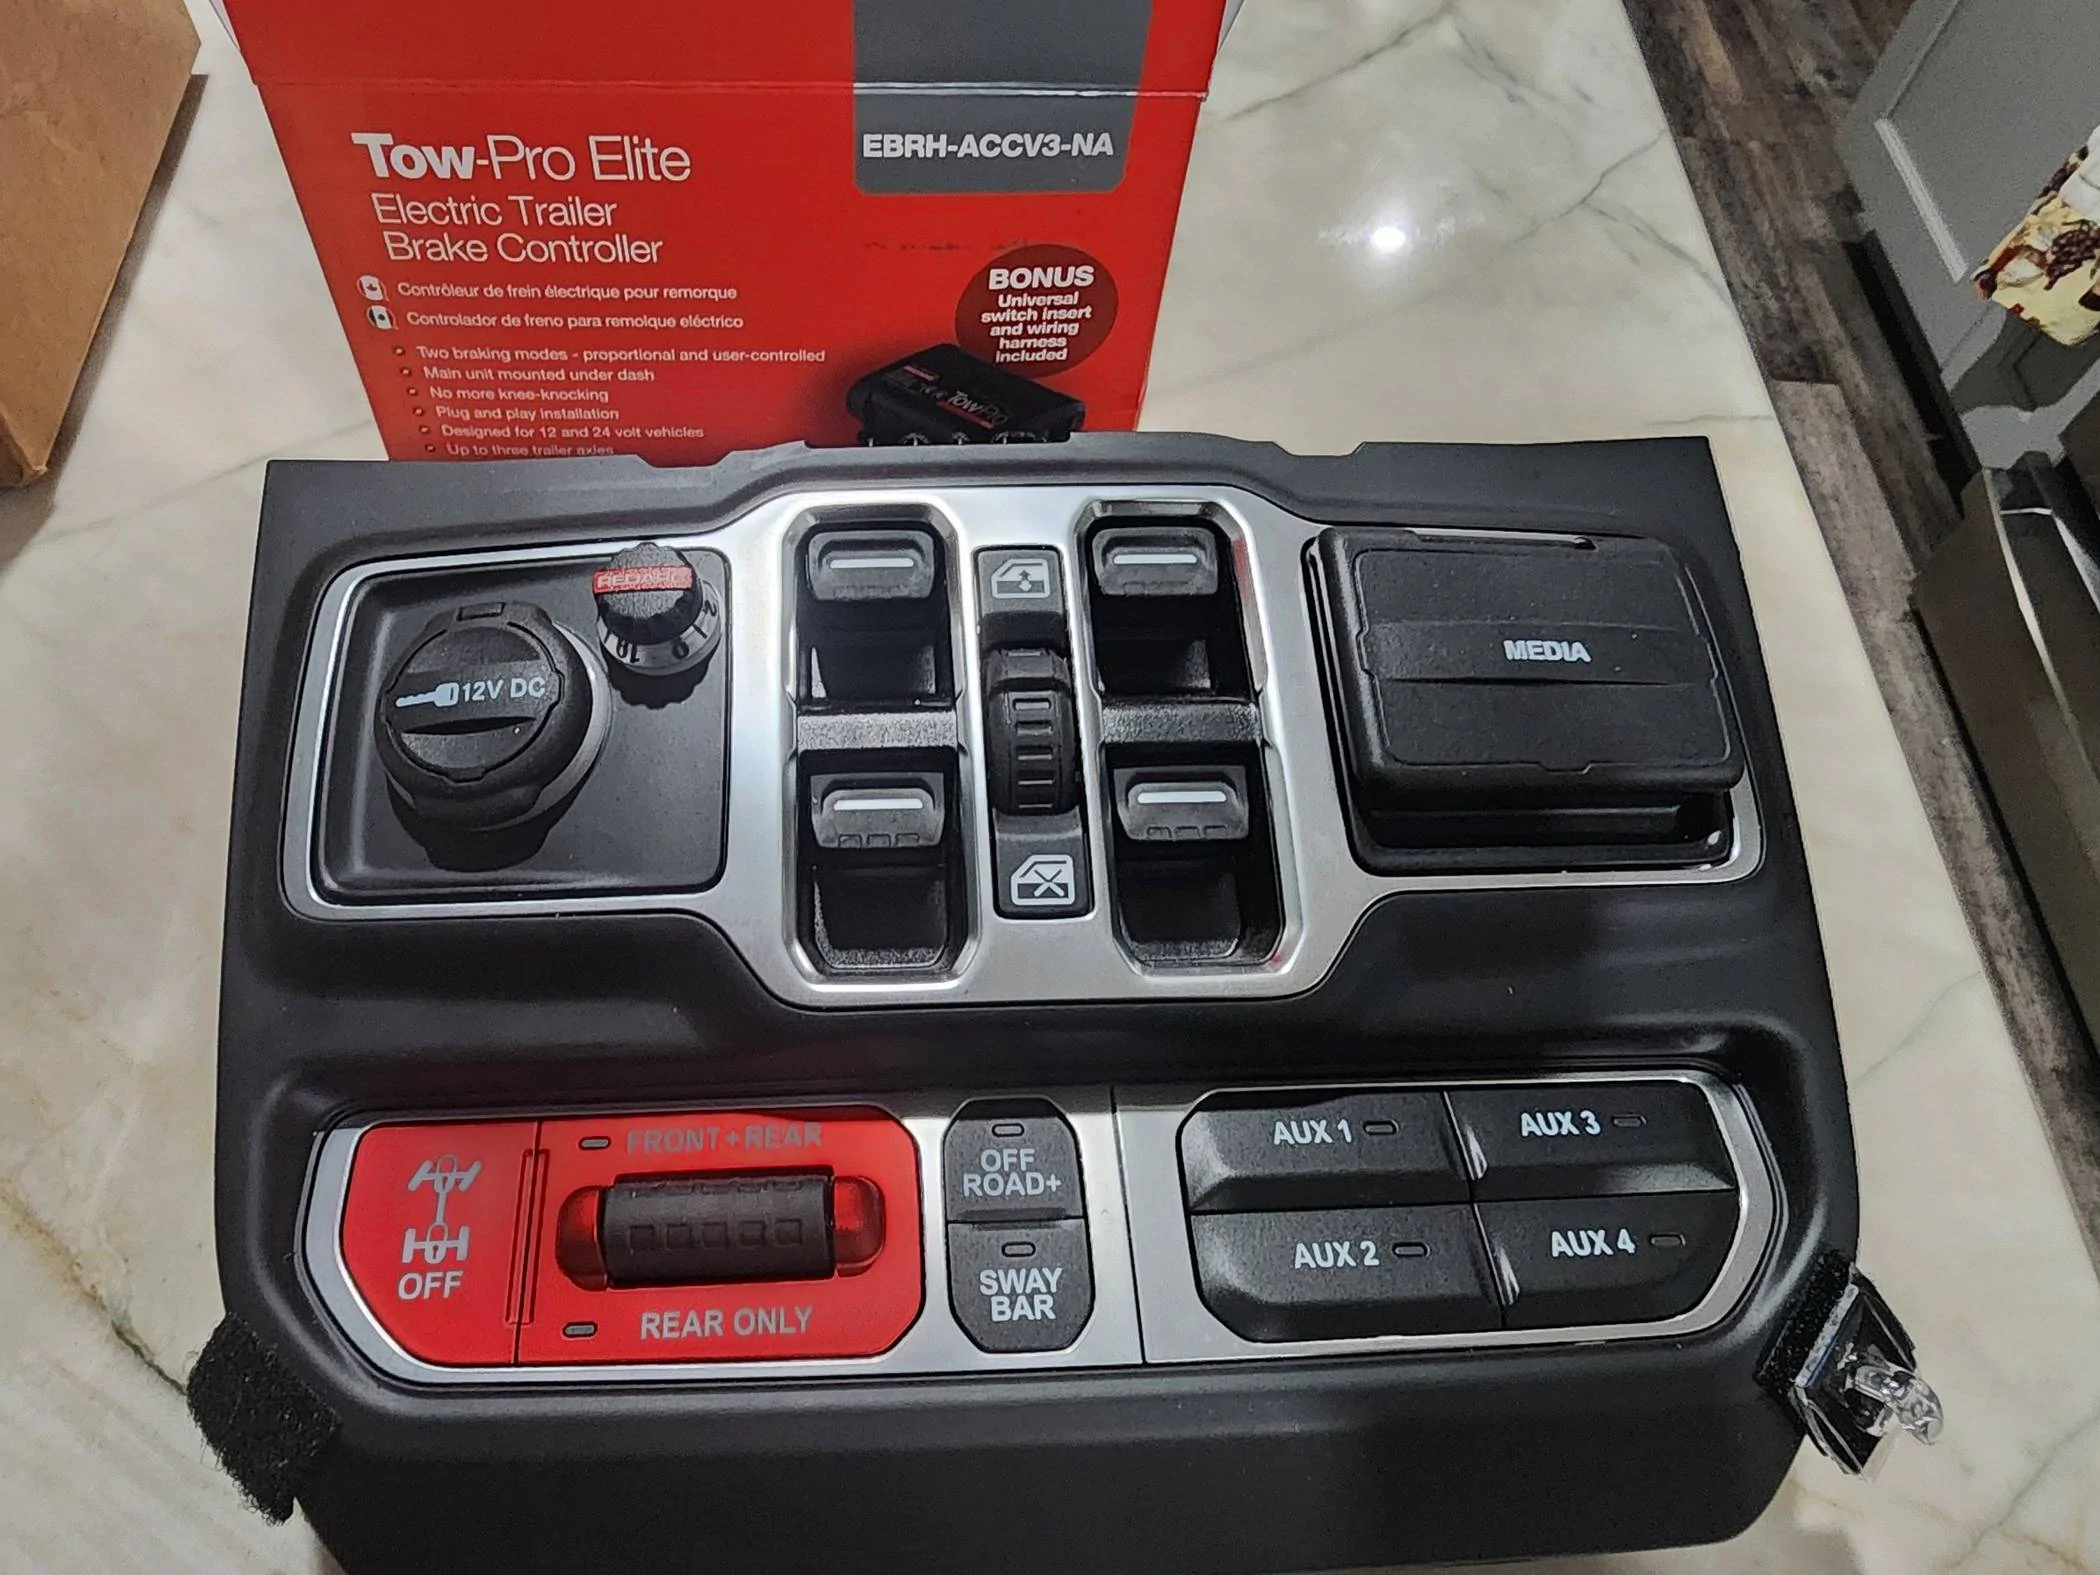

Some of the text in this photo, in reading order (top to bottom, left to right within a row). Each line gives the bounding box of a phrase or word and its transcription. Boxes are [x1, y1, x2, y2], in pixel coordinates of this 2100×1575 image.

[351, 132, 691, 181] Tow-Pro Elite
[863, 133, 1115, 158] EBRH-ACCV3-NA
[371, 192, 618, 227] Electric Trailer
[383, 230, 664, 264] Brake Controller
[988, 265, 1095, 290] BONUS
[398, 281, 737, 301] Contrôleur de frein électrique pour remorque
[997, 292, 1079, 308] Universal
[406, 311, 744, 330] Controlador de freno para remolque eléctrico
[981, 305, 1092, 324] switch insert
[990, 321, 1080, 339] and wiring
[416, 345, 449, 359] Two
[452, 346, 511, 363] braking
[514, 347, 568, 361] modes
[583, 348, 675, 363] proportional
[680, 348, 708, 361] and
[713, 350, 826, 362] user-controlled
[999, 336, 1067, 351] harness
[995, 349, 1068, 363] included
[423, 366, 655, 381] Main unit mounted under dash
[429, 386, 609, 403] No more knee-knocking
[435, 405, 619, 421] Plug and play installation
[441, 424, 704, 440] Designed for 12 and 24 volt vehicles
[446, 443, 467, 457] Up
[472, 443, 488, 456] to
[491, 443, 528, 456] three
[531, 443, 571, 456] trailer
[1503, 639, 1592, 662] MEDIA
[462, 677, 547, 701] 12V DC
[1273, 1119, 1353, 1146] AUX 1
[1520, 1110, 1601, 1137] AUX 3
[980, 1148, 1036, 1172] OFF
[963, 1172, 1062, 1197] ROAD+
[1293, 1240, 1380, 1269] AUX 2
[1551, 1228, 1637, 1257] AUX 4
[398, 1270, 464, 1300] OFF
[979, 1267, 1063, 1295] SWAY
[991, 1294, 1056, 1321] BAR
[641, 1306, 814, 1339] REAR ONLY
